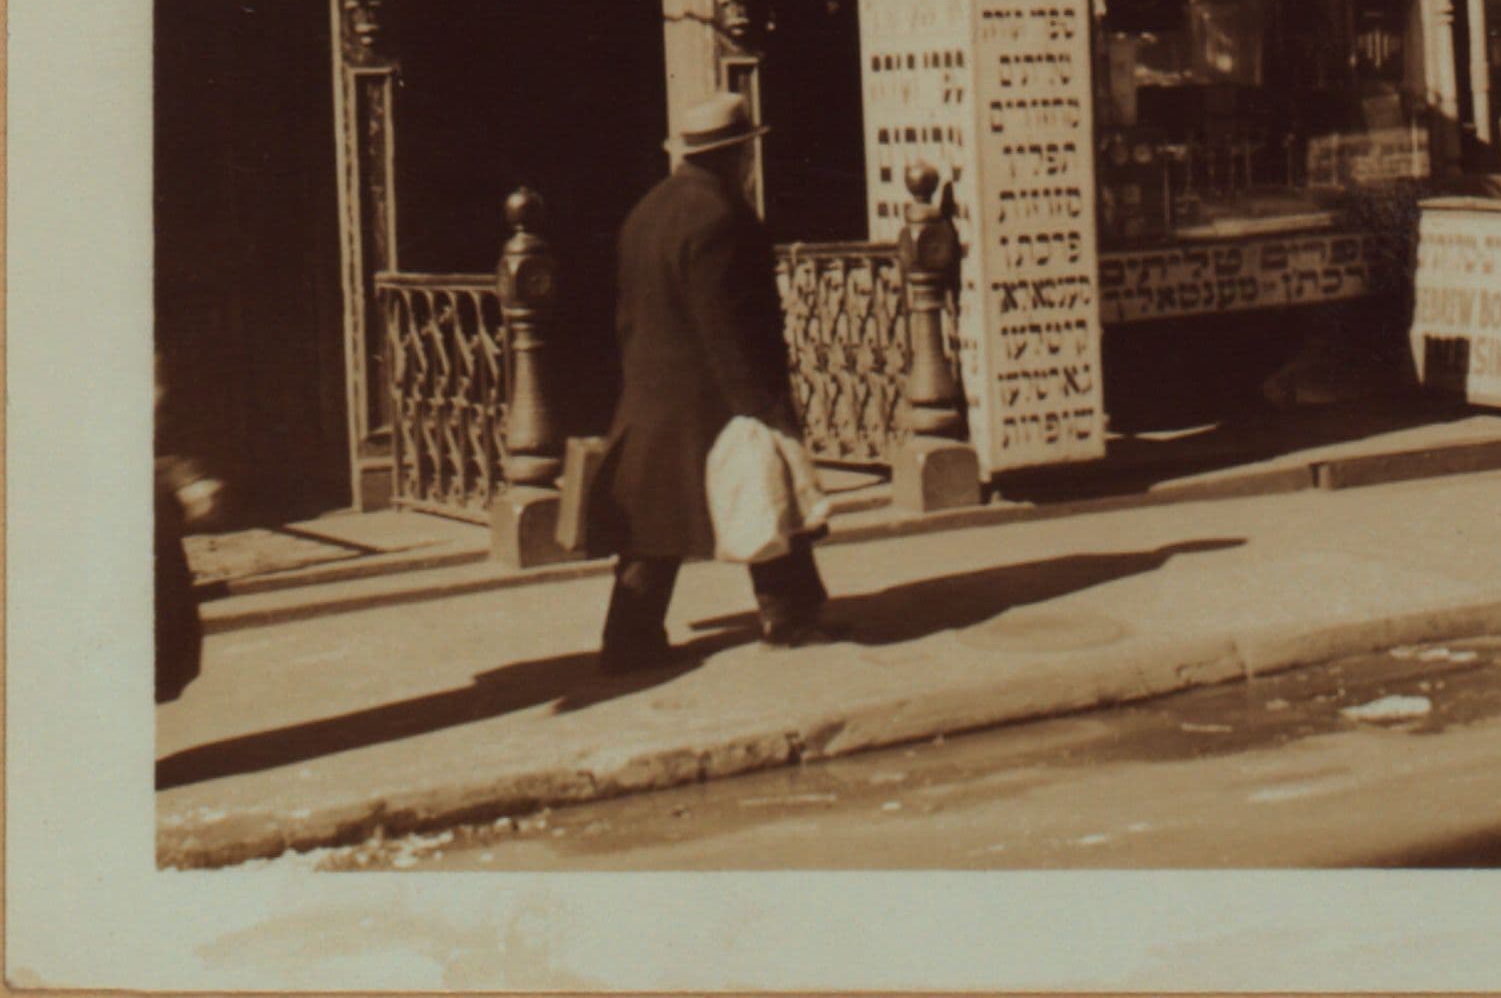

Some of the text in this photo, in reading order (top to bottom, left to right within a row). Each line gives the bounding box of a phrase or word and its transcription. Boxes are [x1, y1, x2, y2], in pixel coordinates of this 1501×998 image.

[989, 97, 1081, 133] מחזורים
[1101, 238, 1374, 289] פרים טליתים
